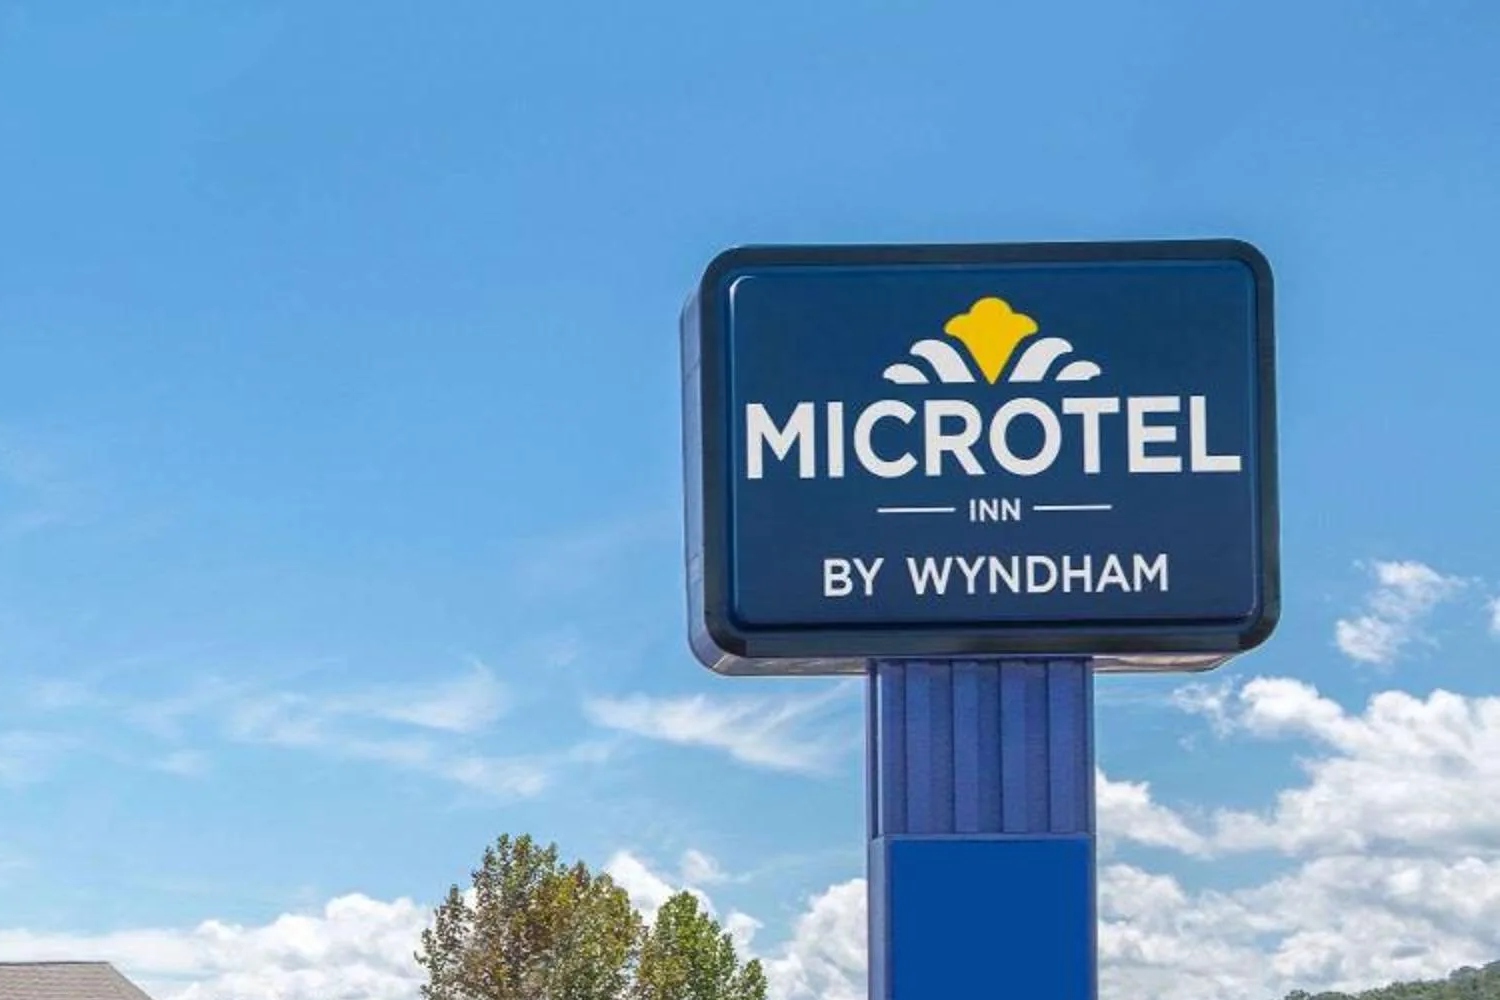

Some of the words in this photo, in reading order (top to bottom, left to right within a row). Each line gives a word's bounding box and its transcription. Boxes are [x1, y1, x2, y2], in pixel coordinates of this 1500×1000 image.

[746, 396, 1241, 478] MICROTEL
[970, 499, 1020, 521] INN
[824, 557, 884, 596] BY
[907, 553, 1168, 595] WYNDHAM
